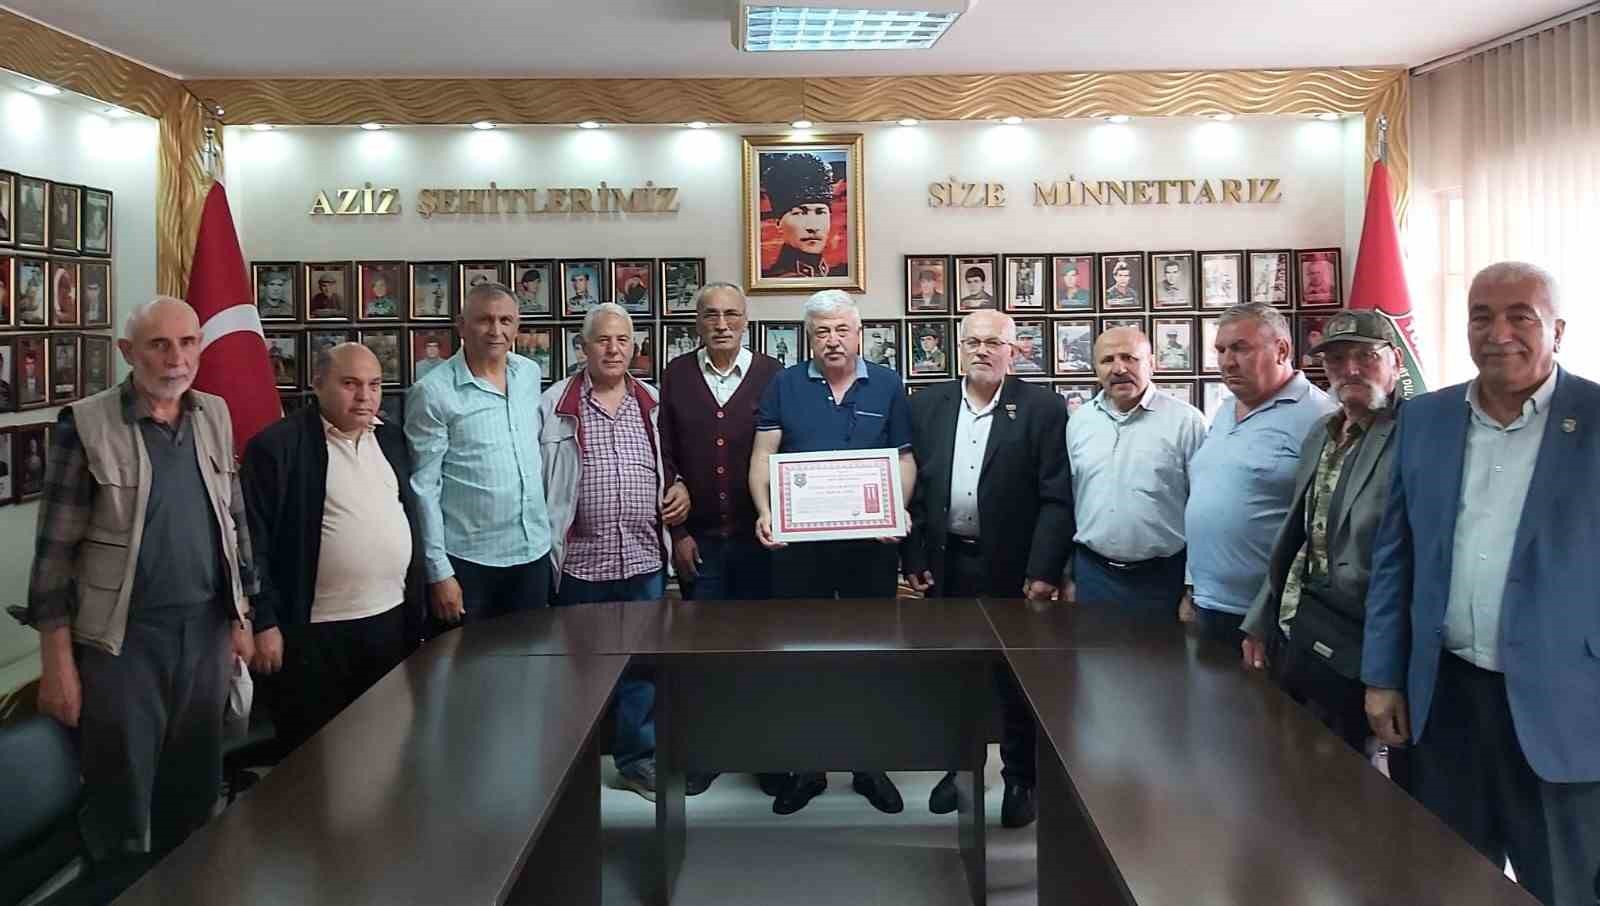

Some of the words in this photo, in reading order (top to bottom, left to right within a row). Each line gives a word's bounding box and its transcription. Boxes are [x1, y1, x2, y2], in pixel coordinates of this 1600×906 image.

[308, 181, 401, 216] AZİZ
[416, 180, 680, 218] ŞEHİTLERİMİZ
[928, 174, 1006, 209] SİZE
[1033, 173, 1282, 207] MİNNETTARIZ
